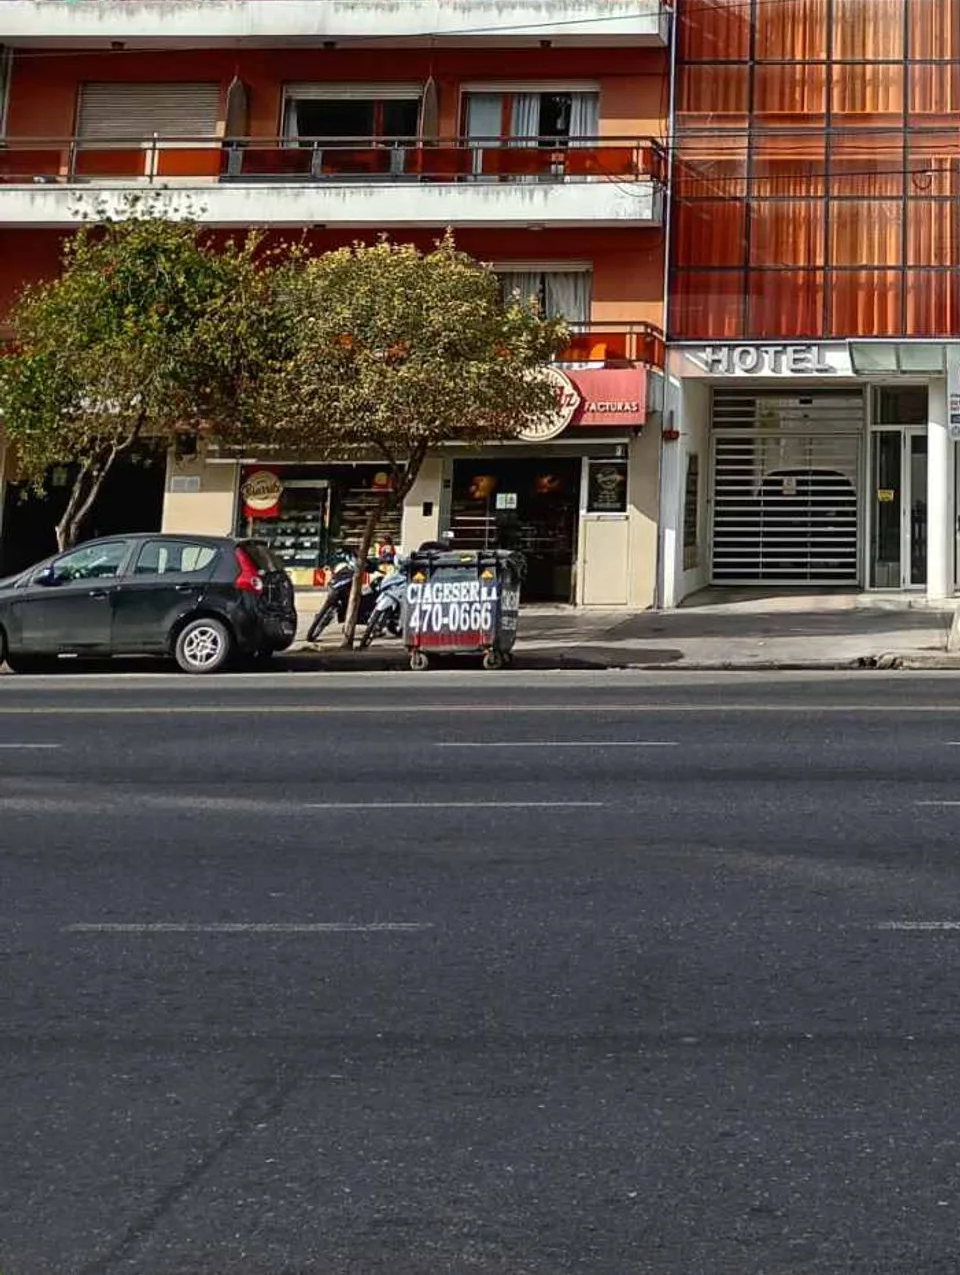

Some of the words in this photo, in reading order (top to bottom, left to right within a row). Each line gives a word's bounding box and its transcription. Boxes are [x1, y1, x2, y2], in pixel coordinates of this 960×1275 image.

[704, 345, 830, 373] HOTEL
[585, 400, 638, 413] FACTURAS
[407, 581, 480, 604] CIAGESER
[409, 601, 492, 633] 470-0666
